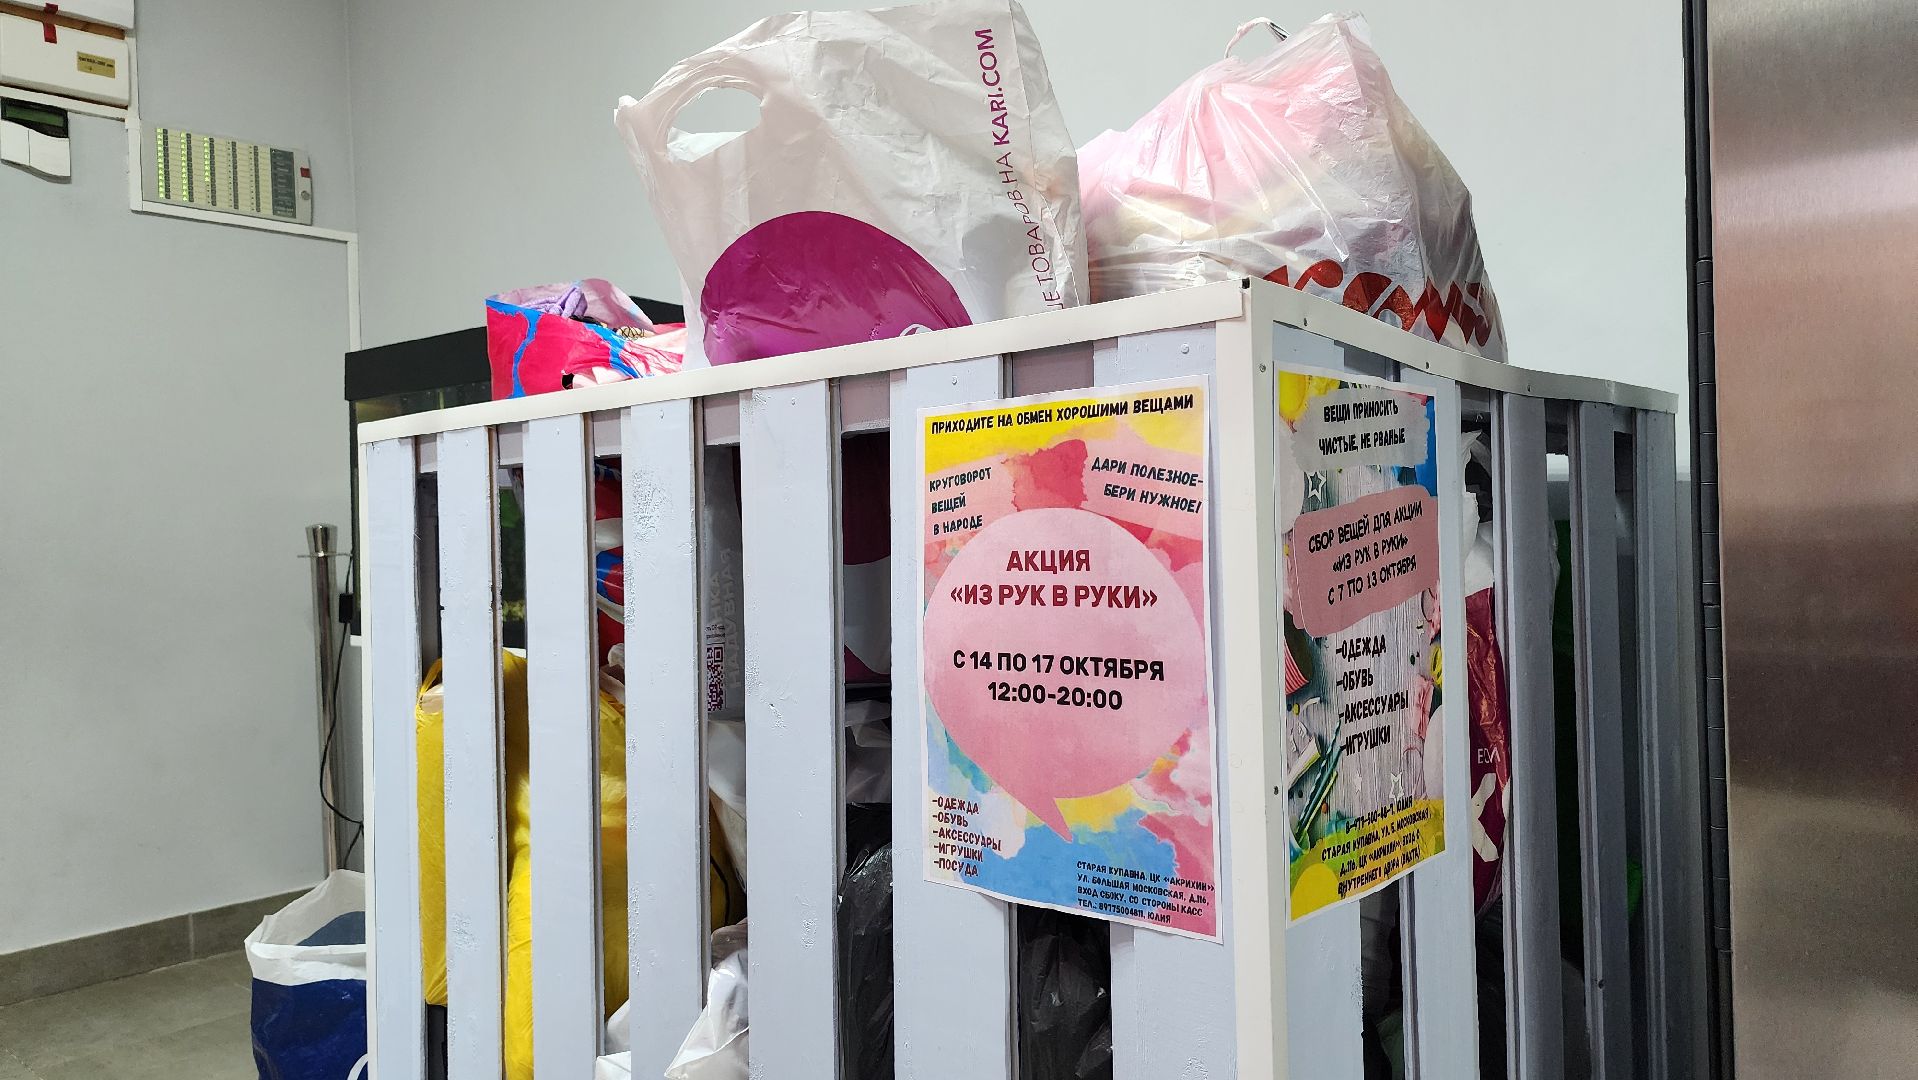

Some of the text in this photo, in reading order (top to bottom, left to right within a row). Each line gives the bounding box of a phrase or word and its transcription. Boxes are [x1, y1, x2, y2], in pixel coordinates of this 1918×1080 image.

[975, 29, 1009, 145] KARI.COM
[996, 152, 1017, 183] НА
[1007, 189, 1053, 286] ТОВАРОВ
[931, 394, 1194, 435] ПРИХОДИТЕ НА ОБМЕН ХОРОШИМИ ВЕЩАМИ
[1323, 399, 1399, 424] ВЕЩИ ПРИНОСИТЬ
[1318, 427, 1406, 456] ЧИСТЫЕ, НЕ РВАНЫЕ
[929, 467, 992, 492] КРУГОВОРОТ
[1091, 456, 1203, 487] ДАРИ ПОЛЕЗНОЕ-
[931, 492, 966, 514] ВЕЩЕЙ
[1103, 483, 1202, 514] БЕРИ НУЖНОЕ!
[933, 515, 983, 536] В НАРОДЕ
[1308, 501, 1423, 553] СБОР ВЕЩЕЙ ДЛЯ АКЦИИ
[1006, 549, 1091, 575] АКЦИЯ
[1332, 533, 1408, 573] «ИЗ РУК В РУКИ»
[1327, 554, 1417, 605] С 7 ПО 13 ОКТЯБРЯ
[951, 584, 1158, 609] «ИЗ РУК В РУКИ»
[1335, 634, 1387, 662] -ОДЕЖДА
[953, 650, 1165, 682] С 14 ПО 17 ОКТЯБРЯ
[1336, 667, 1374, 691] -ОБУВЬ
[987, 681, 1123, 711] 12:00-20:00
[1338, 689, 1409, 724] -АКСЕССУАРЫ
[1340, 724, 1391, 756] -ИГРУШКИ
[932, 796, 980, 816] -ОДЕЖДА
[1396, 795, 1413, 813] ЮЛИЯ
[932, 811, 969, 828] -ОБУВЬ
[932, 827, 1002, 852] -АКСЕССУАРЫ
[933, 842, 984, 863] -ИГРУШКИ
[1321, 841, 1351, 861] СТАРАЯ
[933, 857, 979, 878] -ПОСУДА
[1076, 860, 1107, 874] СТАРАЯ
[1150, 872, 1161, 884] ЦК
[1359, 855, 1368, 869] ЦК
[1077, 873, 1090, 884] УЛ.
[1092, 877, 1130, 891] БОЛЬШАЯ
[1132, 882, 1187, 902] МОСКОВСКАЯ,
[1077, 886, 1099, 899] ВХОД
[1129, 895, 1139, 905] СО
[1141, 897, 1180, 913] СТОРОНЫ
[1181, 905, 1203, 917] КАСС
[1147, 912, 1171, 924] ЮЛИЯ
